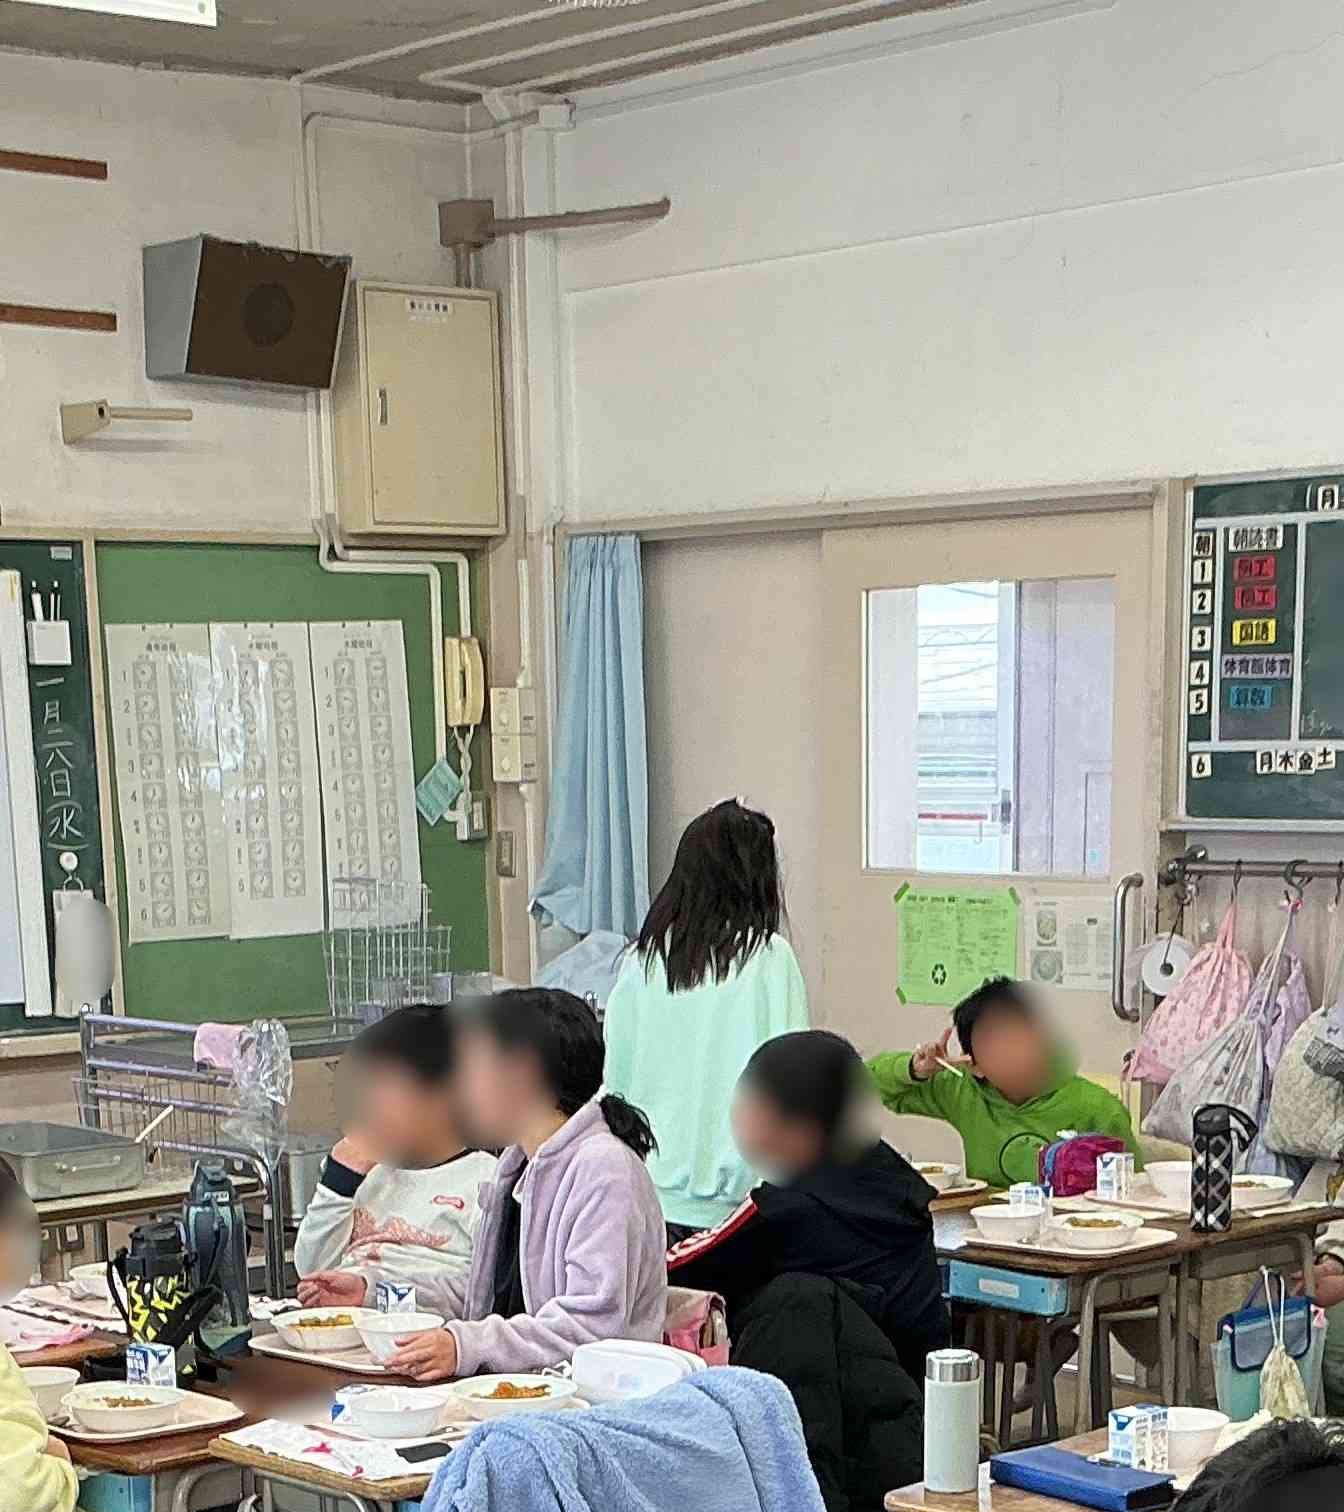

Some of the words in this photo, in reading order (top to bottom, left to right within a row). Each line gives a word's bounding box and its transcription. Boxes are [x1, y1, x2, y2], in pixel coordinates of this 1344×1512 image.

[1201, 561, 1206, 579] 1
[1198, 592, 1206, 611] 2
[1197, 630, 1206, 648] 3
[1196, 663, 1204, 683] 4
[1195, 694, 1204, 711] 5
[1196, 757, 1205, 775] 6
